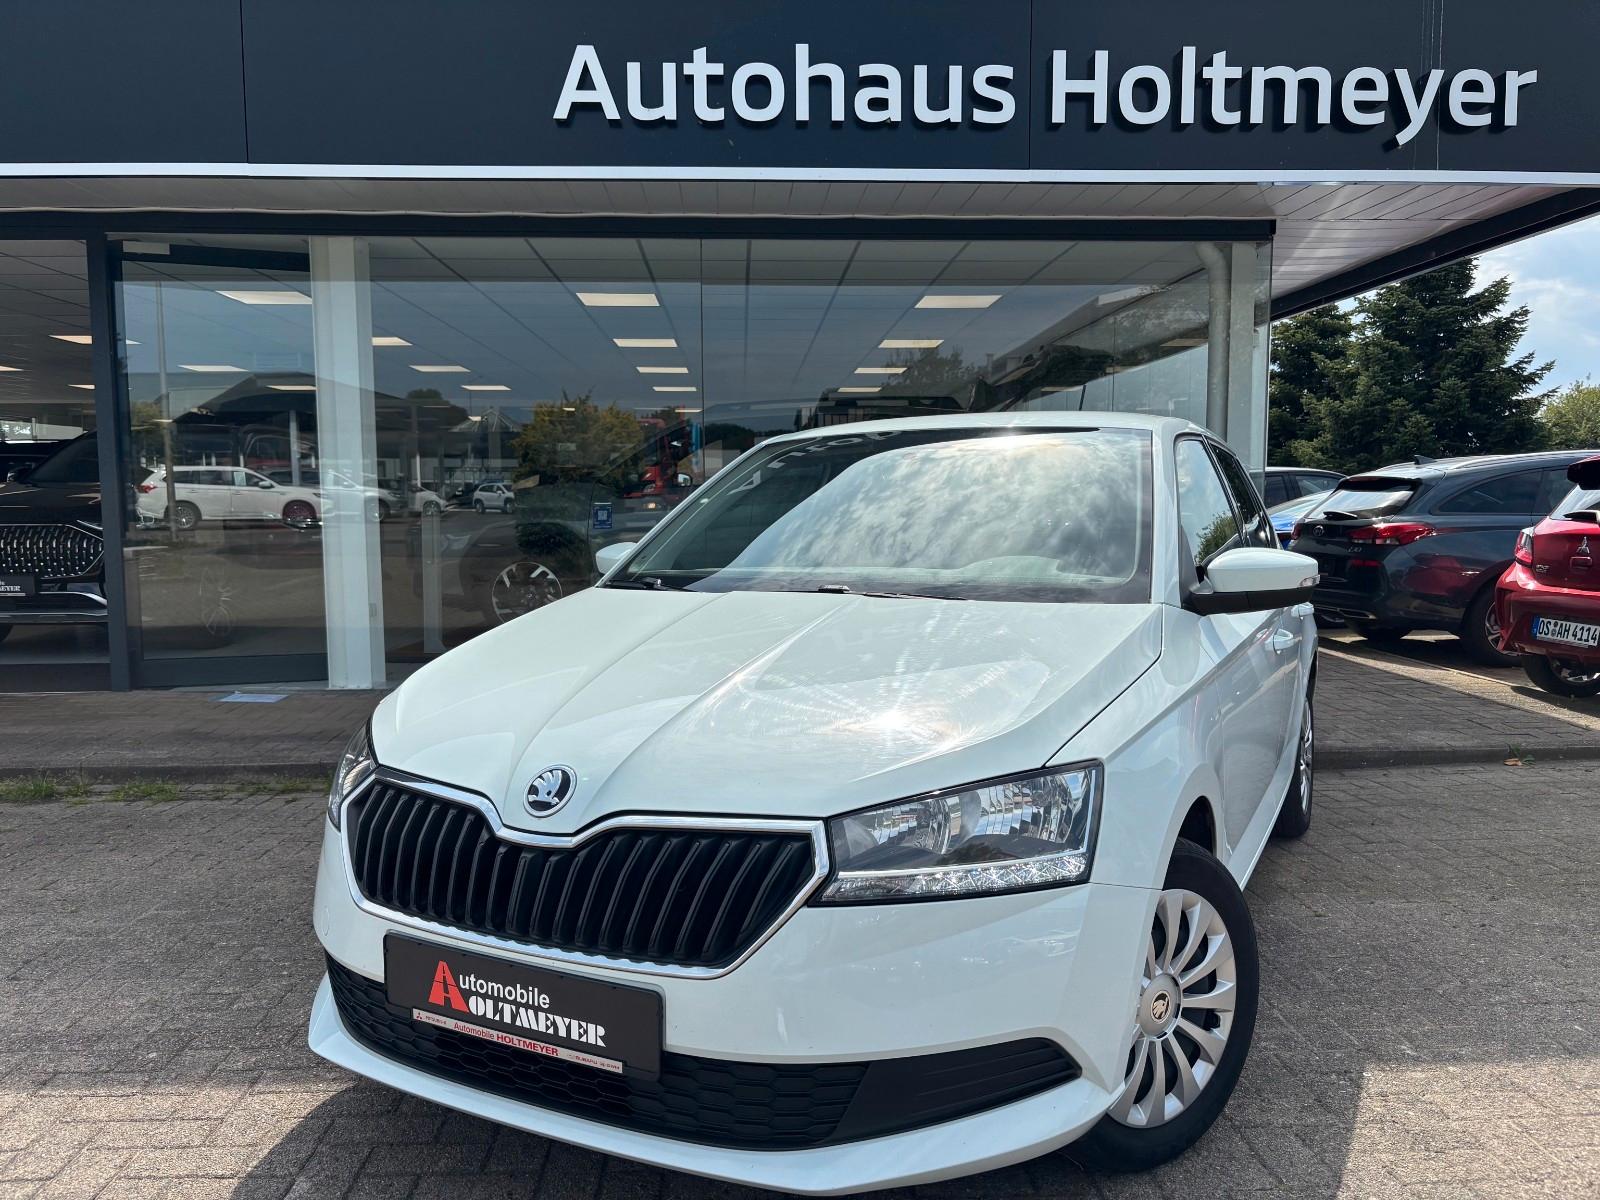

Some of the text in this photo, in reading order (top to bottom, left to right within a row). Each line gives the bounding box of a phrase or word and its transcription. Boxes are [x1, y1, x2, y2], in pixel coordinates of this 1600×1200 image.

[552, 43, 1538, 146] Autohaus Holtmeyer
[1538, 619, 1598, 644] OS AH 4114
[428, 960, 551, 1013] Automobile
[454, 1022, 495, 1040] Automobile
[496, 1033, 559, 1057] HOLTMEYER
